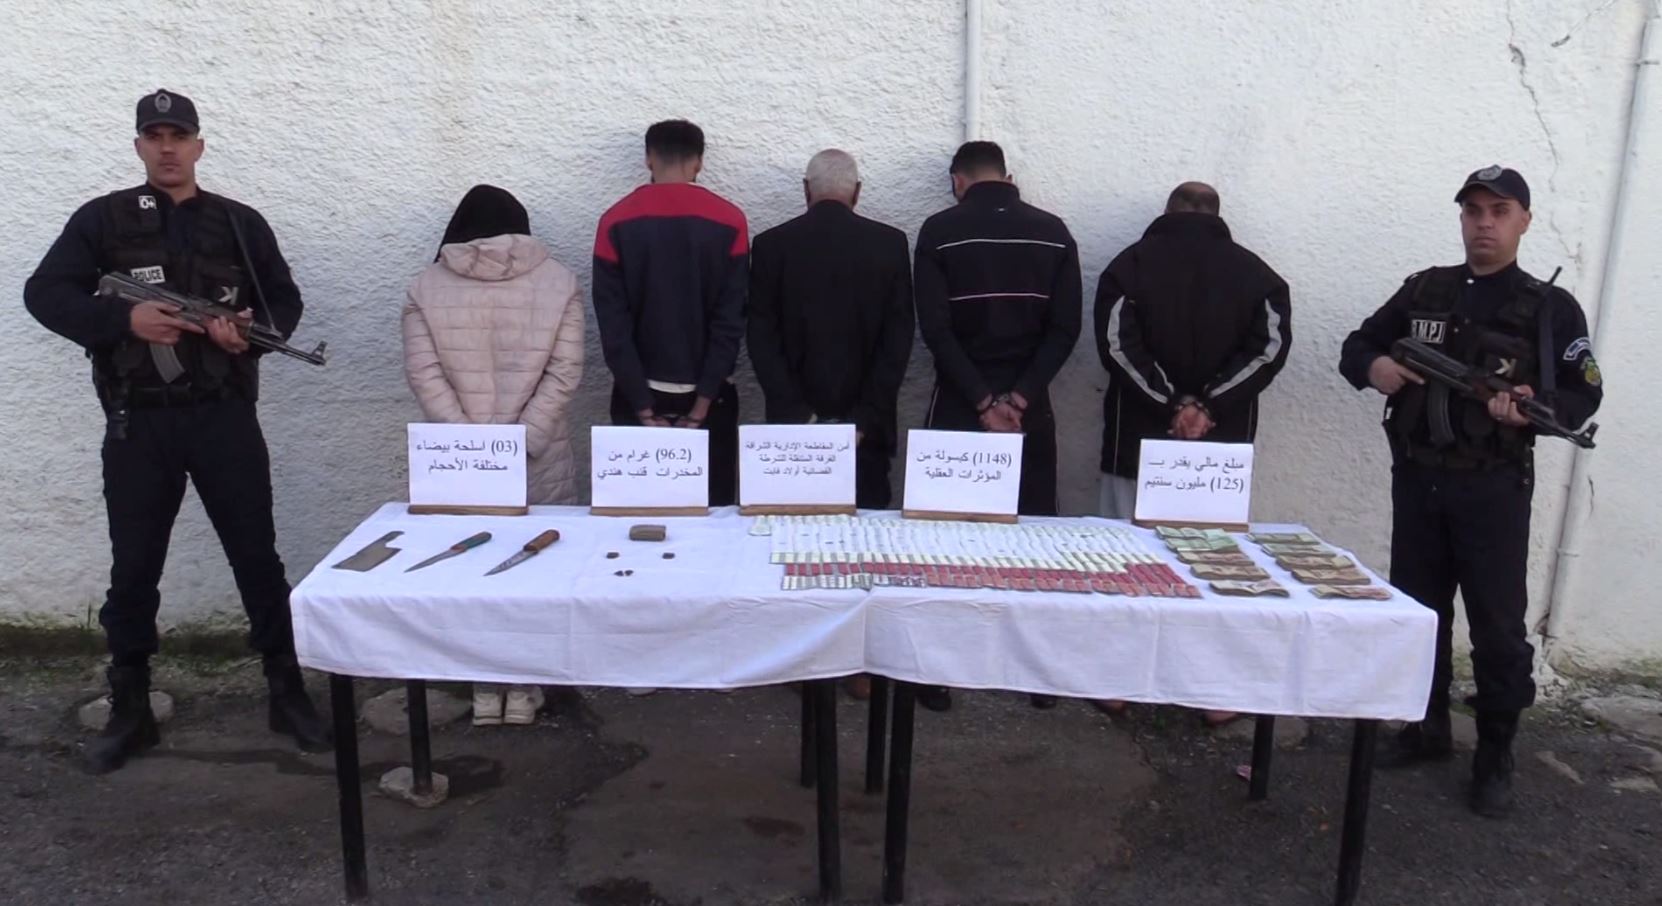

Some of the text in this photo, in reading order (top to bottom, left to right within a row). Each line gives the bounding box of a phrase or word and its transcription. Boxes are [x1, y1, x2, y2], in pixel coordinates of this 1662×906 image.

[133, 268, 163, 281] POLICE
[416, 440, 450, 453] بيضاء
[491, 440, 518, 457] (03)
[608, 448, 692, 464] (96.2) غرام من
[815, 454, 836, 464] الفرقة
[916, 450, 1012, 468] (1148) كبسولة من
[1170, 456, 1191, 470] يقدر
[428, 457, 508, 475] مختلفة الأحجام
[597, 464, 703, 479] المخدرات قنب هندي
[1194, 457, 1219, 472] مالي
[1222, 457, 1244, 474] مبلغ
[925, 466, 1002, 483] المؤثرات العقلية
[1145, 476, 1244, 494] (125) مليون سنتيم
